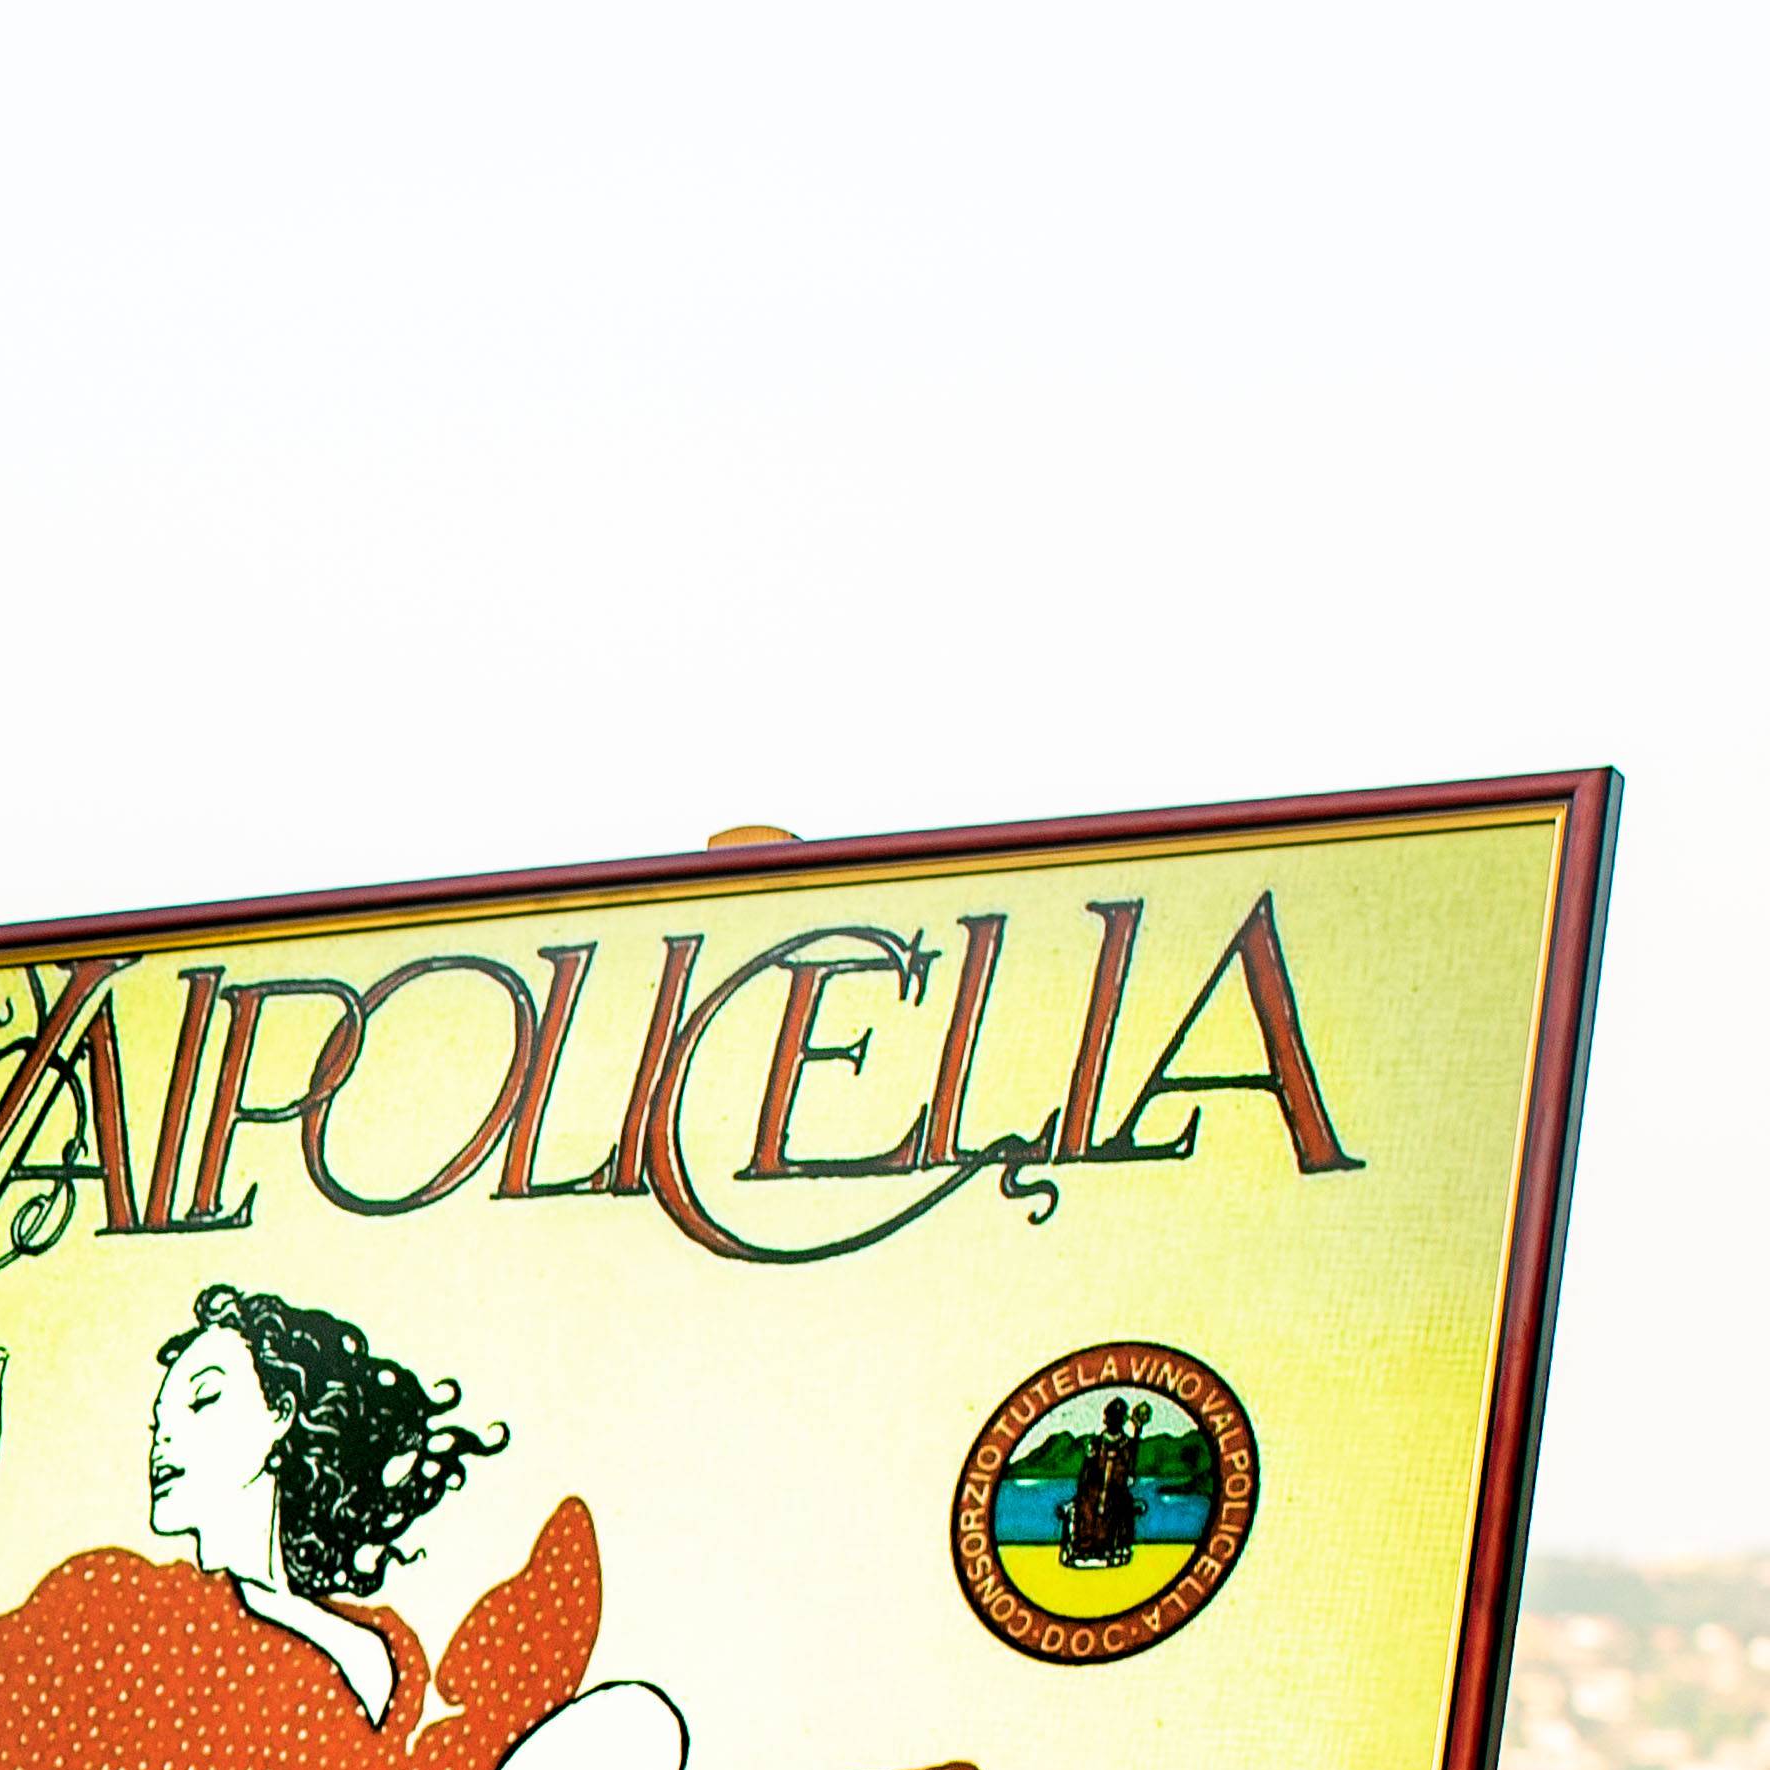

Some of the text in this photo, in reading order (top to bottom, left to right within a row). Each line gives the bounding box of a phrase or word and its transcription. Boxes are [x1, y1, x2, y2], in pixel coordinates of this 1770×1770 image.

[993, 1353, 1119, 1440] TUTELA
[1129, 1355, 1203, 1399] VINO
[960, 1443, 1034, 1637] CONSORZIO
[1142, 1388, 1252, 1632] VALPOLICELLA
